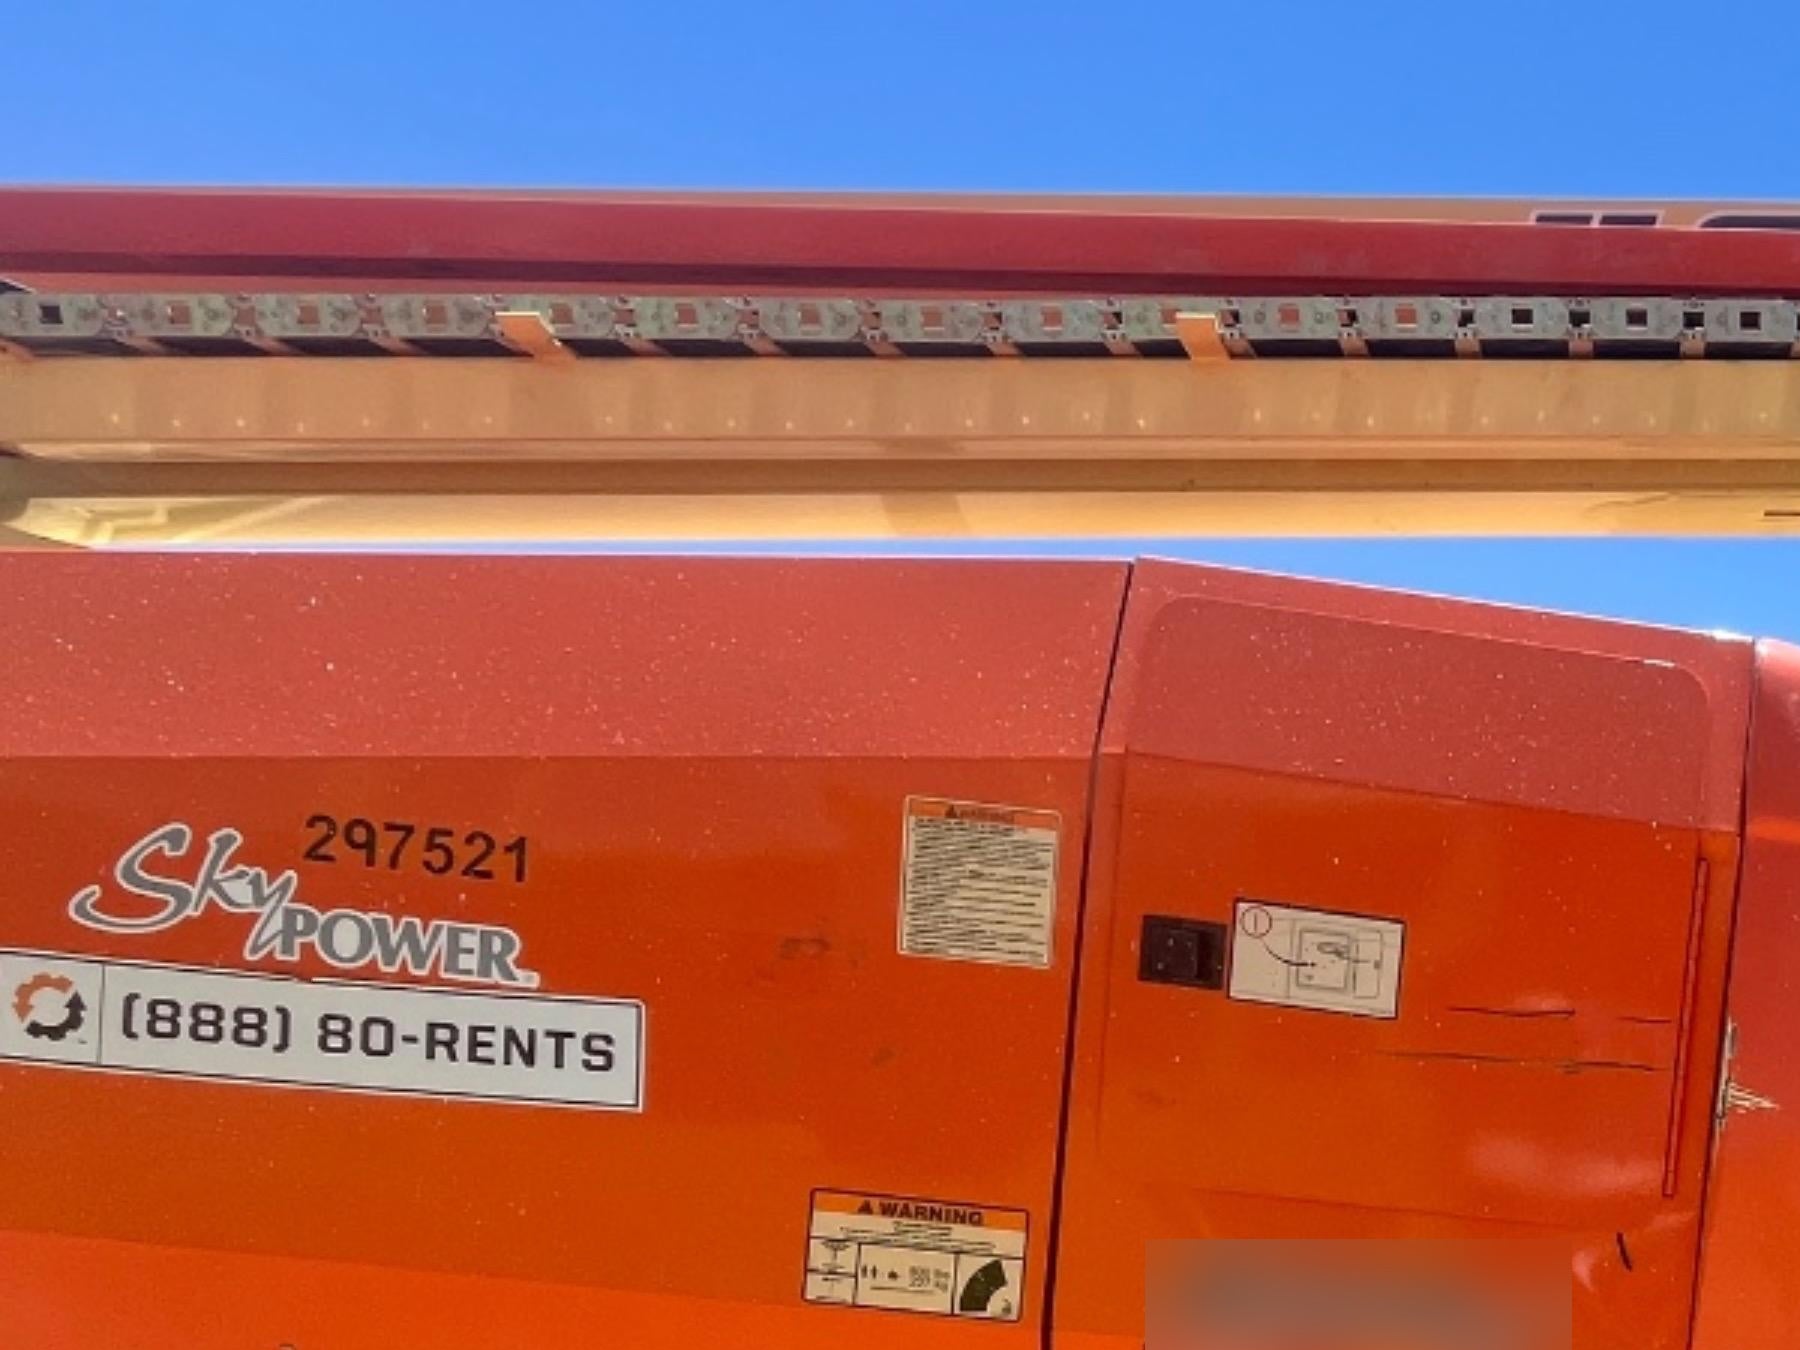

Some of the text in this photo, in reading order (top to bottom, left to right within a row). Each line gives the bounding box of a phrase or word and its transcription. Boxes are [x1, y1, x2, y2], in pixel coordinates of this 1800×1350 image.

[303, 814, 530, 883] 297521
[274, 900, 524, 985] POWER
[121, 992, 617, 1073] (888) 80-RENTS
[878, 1200, 984, 1227] WARNING
